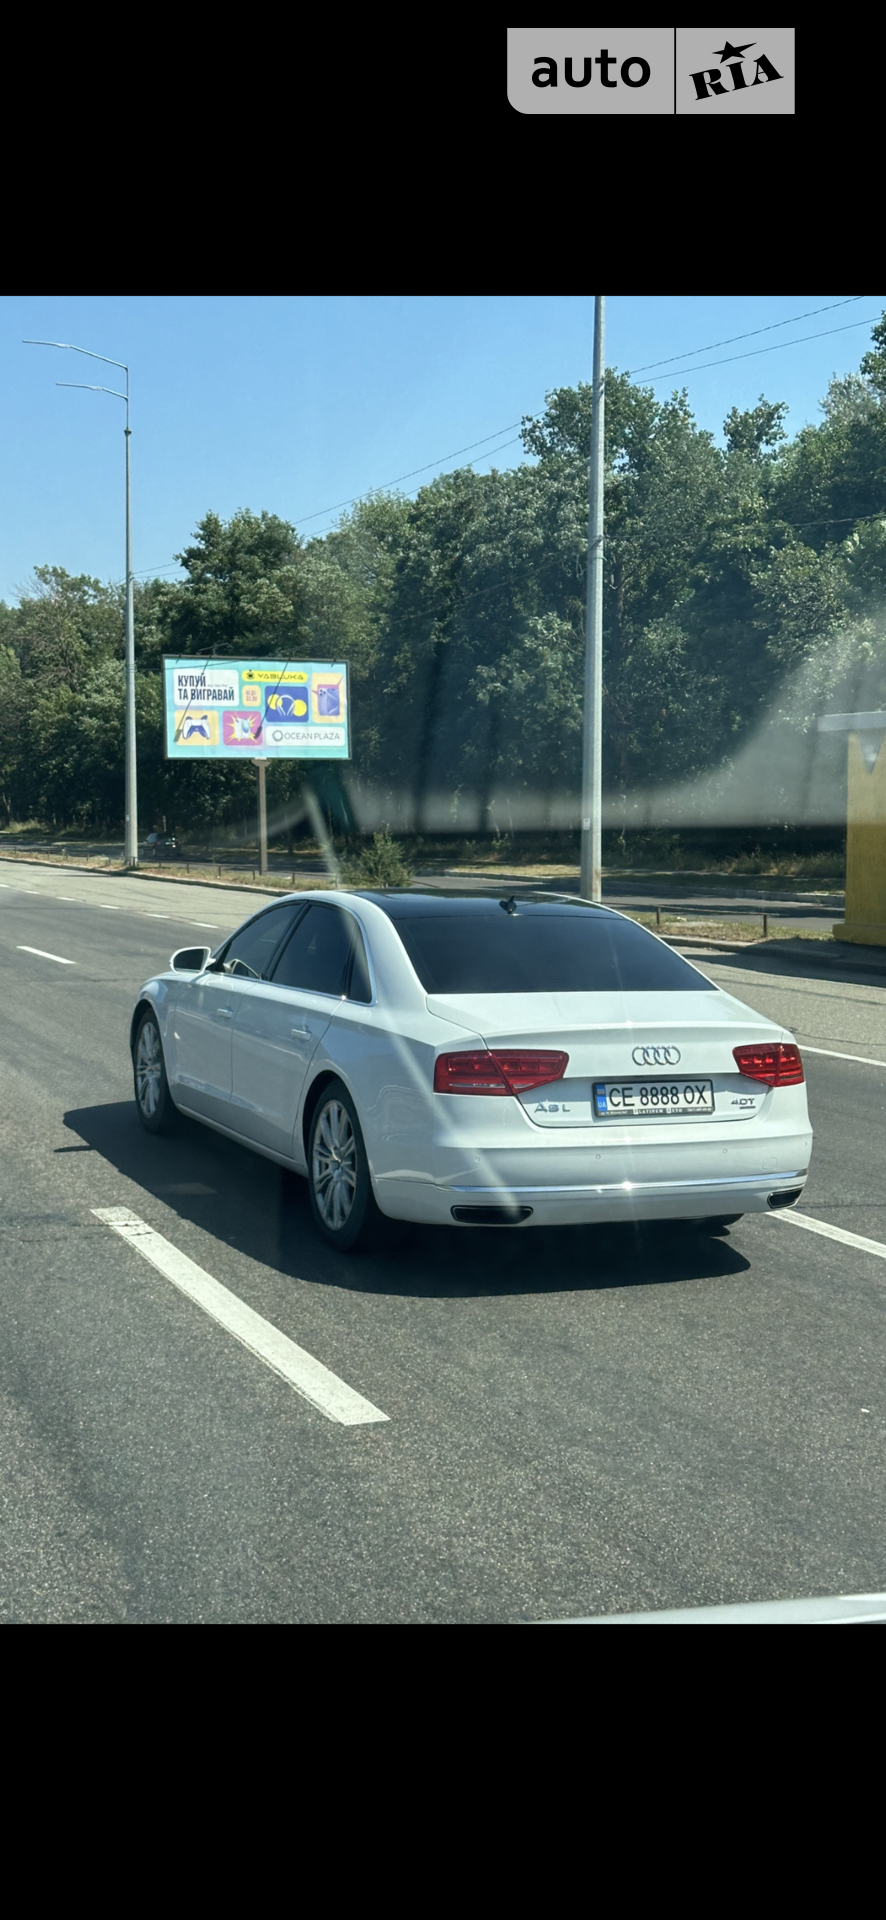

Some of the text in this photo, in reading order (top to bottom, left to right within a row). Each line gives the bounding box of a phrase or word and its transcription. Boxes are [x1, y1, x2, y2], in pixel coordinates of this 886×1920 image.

[178, 673, 206, 687] КУПУЙ
[178, 688, 189, 701] ТА
[190, 687, 234, 701] ВИГРАВАЙ
[609, 1085, 707, 1107] CE 8888 OX
